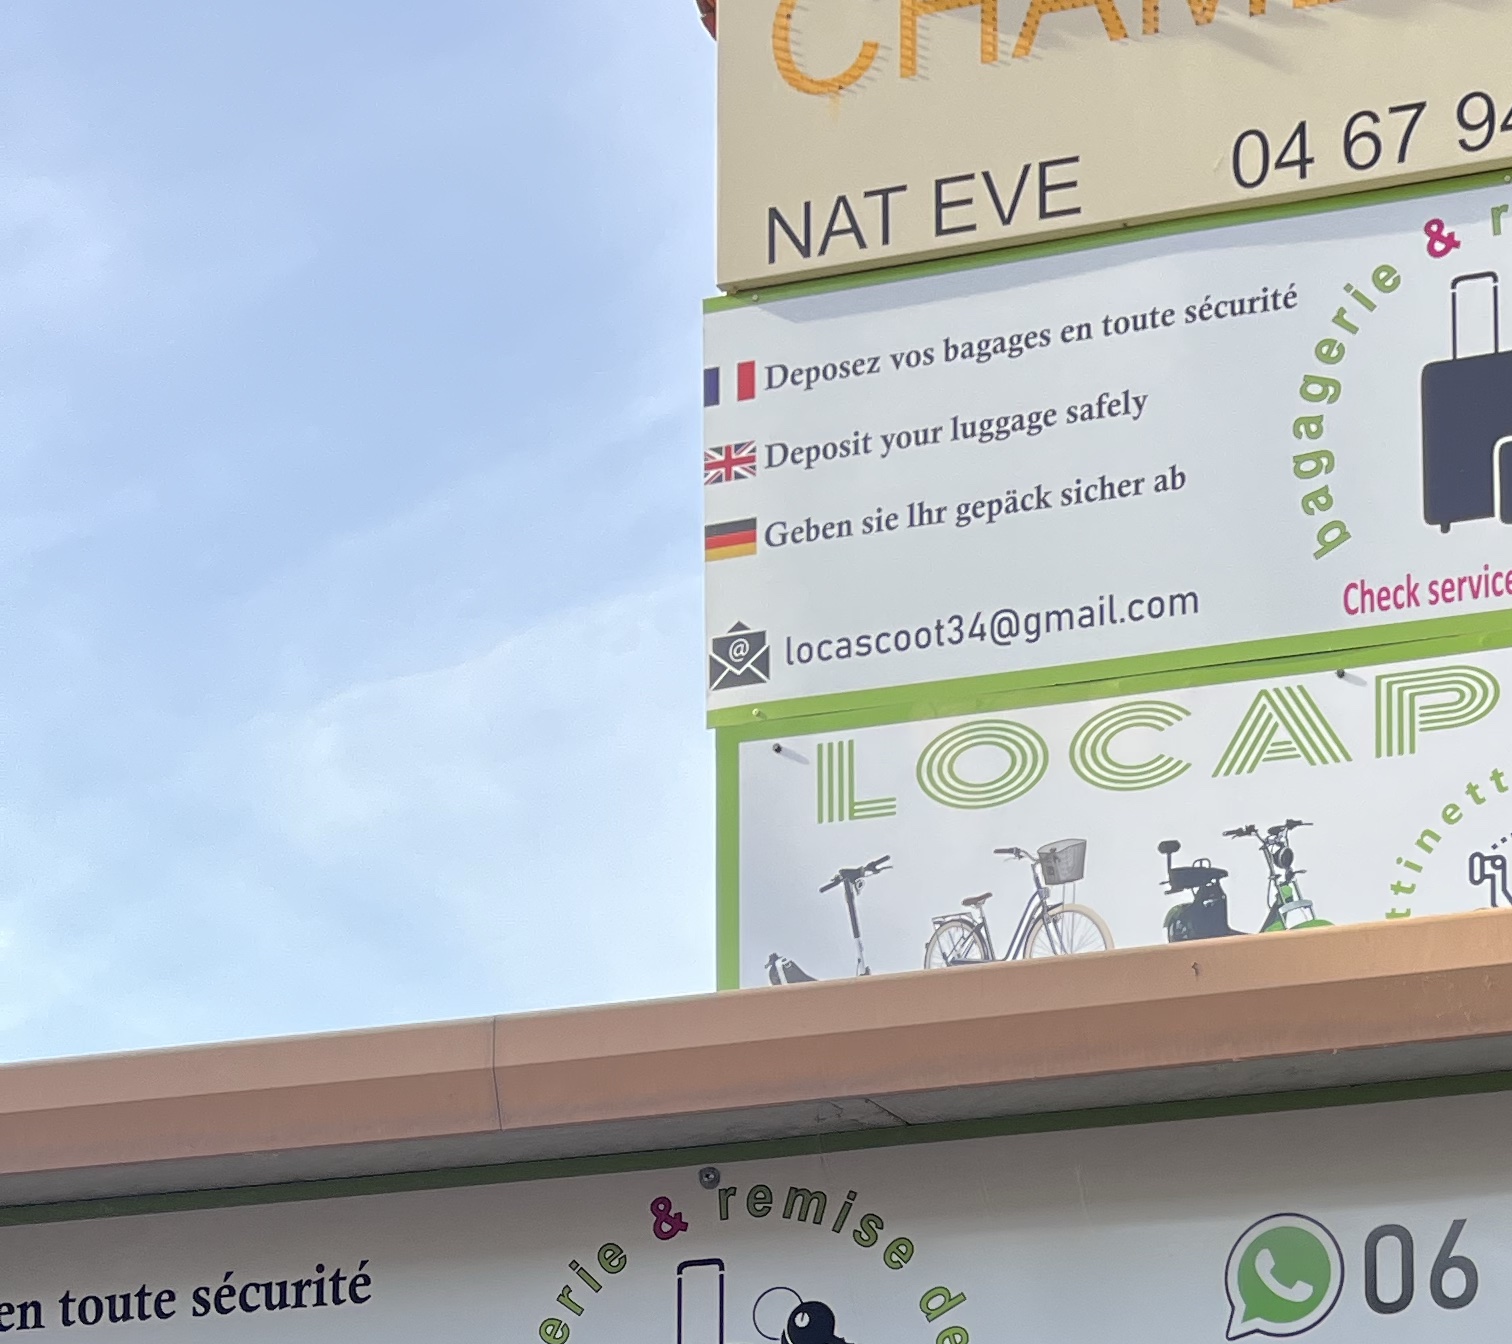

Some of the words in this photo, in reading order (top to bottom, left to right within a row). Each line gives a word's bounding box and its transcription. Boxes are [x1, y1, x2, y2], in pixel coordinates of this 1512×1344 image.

[1231, 122, 1314, 189] 04
[1342, 101, 1427, 170] 67
[766, 185, 907, 264] NAT
[933, 155, 1082, 238] EVE
[765, 354, 881, 392] Deposez
[890, 346, 934, 371] vos
[943, 328, 1052, 364] bagages
[1060, 319, 1093, 345] en
[1101, 306, 1176, 337] toute
[1184, 283, 1299, 324] sécurité
[765, 432, 872, 471] Deposit
[880, 424, 943, 459] your
[950, 406, 1057, 444] luggage
[1066, 389, 1149, 424] safely
[1292, 263, 1401, 560] bagagerie
[1423, 218, 1461, 258] &
[764, 515, 853, 549] Geben
[861, 507, 900, 535] sie
[907, 502, 948, 529] Ihr
[956, 484, 1052, 527] gepäck
[1060, 470, 1146, 507] sicher
[1154, 464, 1187, 492] ab
[785, 589, 1199, 667] locascoot34@gmail.com
[1343, 573, 1421, 616] Check
[816, 664, 1500, 825] LOCAP
[650, 1196, 688, 1240] &
[718, 1184, 915, 1270] remise
[1363, 1218, 1479, 1315] 06
[58, 1284, 177, 1327] toute
[192, 1260, 372, 1317] sécurité
